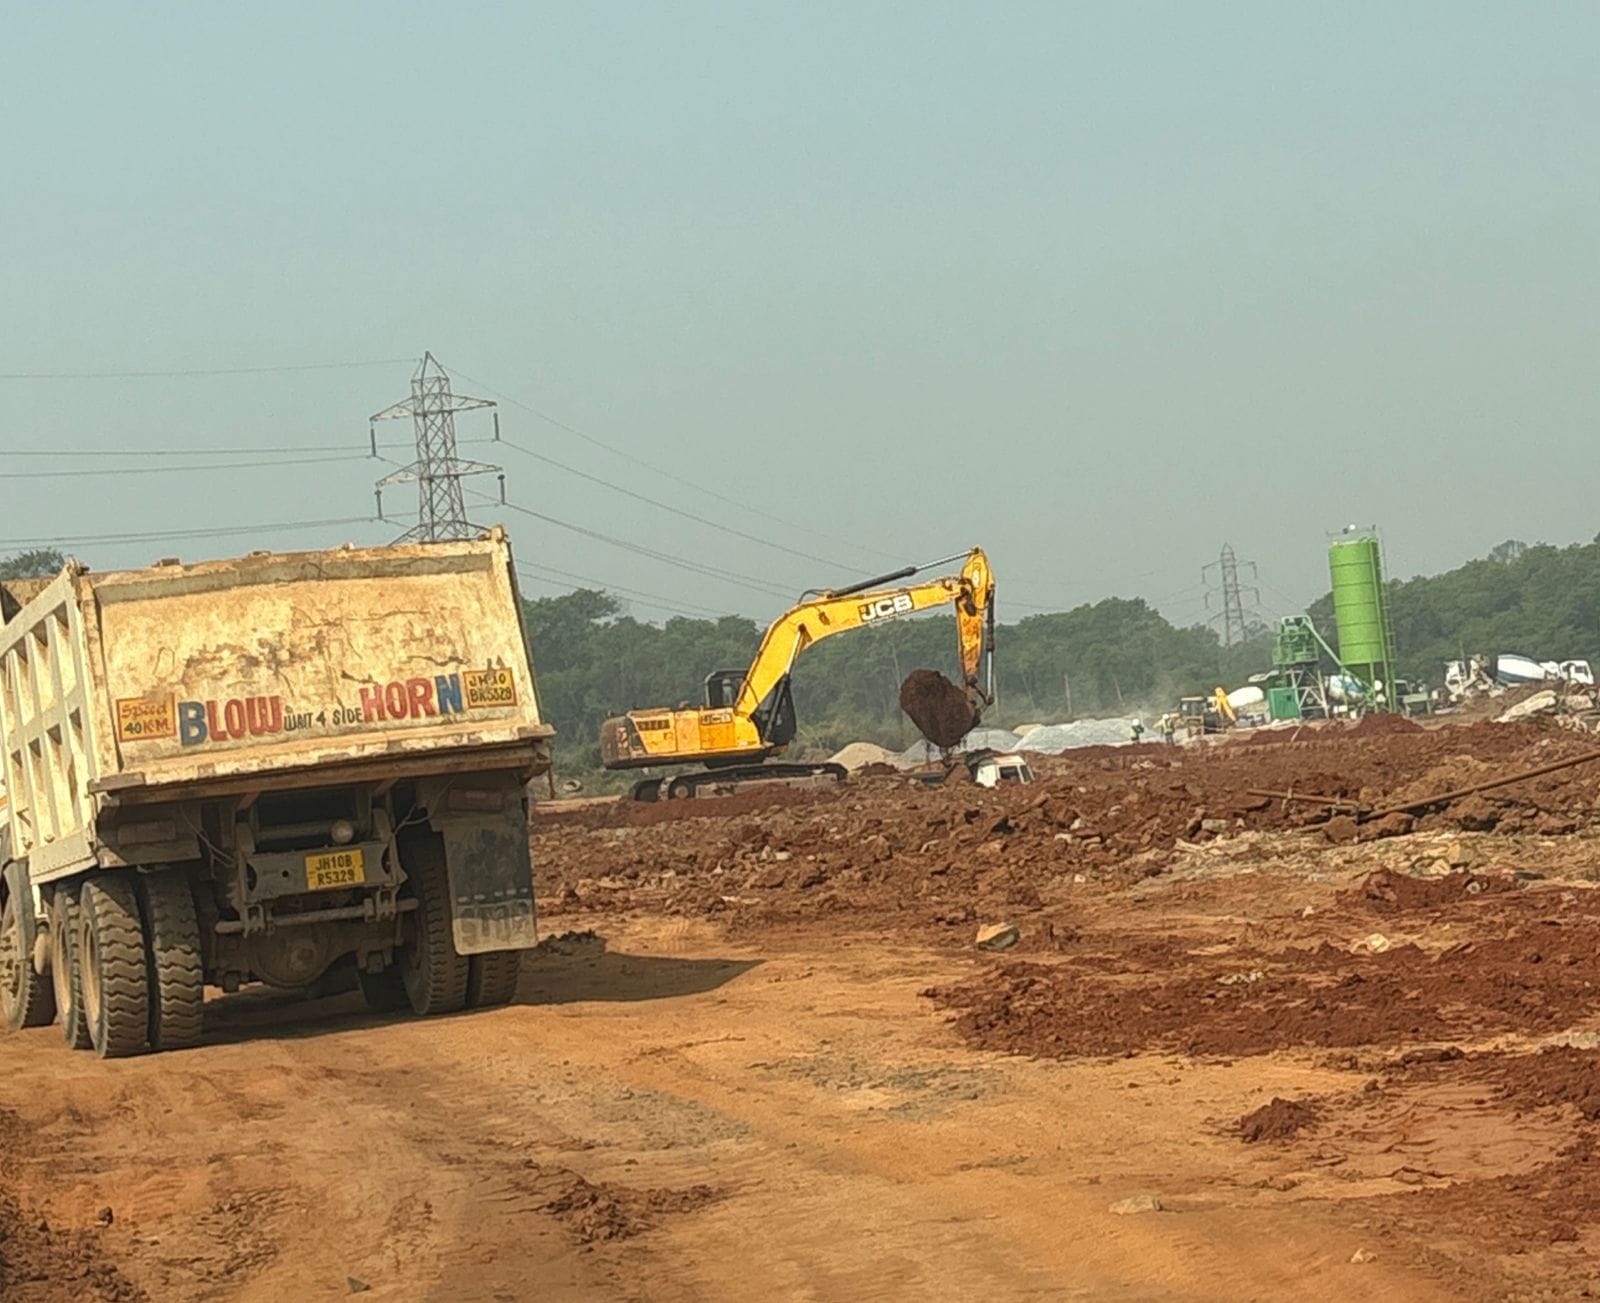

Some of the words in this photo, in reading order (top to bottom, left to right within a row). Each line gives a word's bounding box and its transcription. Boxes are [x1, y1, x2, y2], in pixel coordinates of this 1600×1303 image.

[861, 594, 913, 620] JCB
[121, 701, 168, 720] Speed
[177, 695, 283, 746] BLOW
[315, 711, 327, 727] 4
[332, 707, 363, 725] SIDE
[359, 673, 464, 723] HORN
[315, 854, 352, 871] JH10B
[317, 869, 355, 886] R5329
